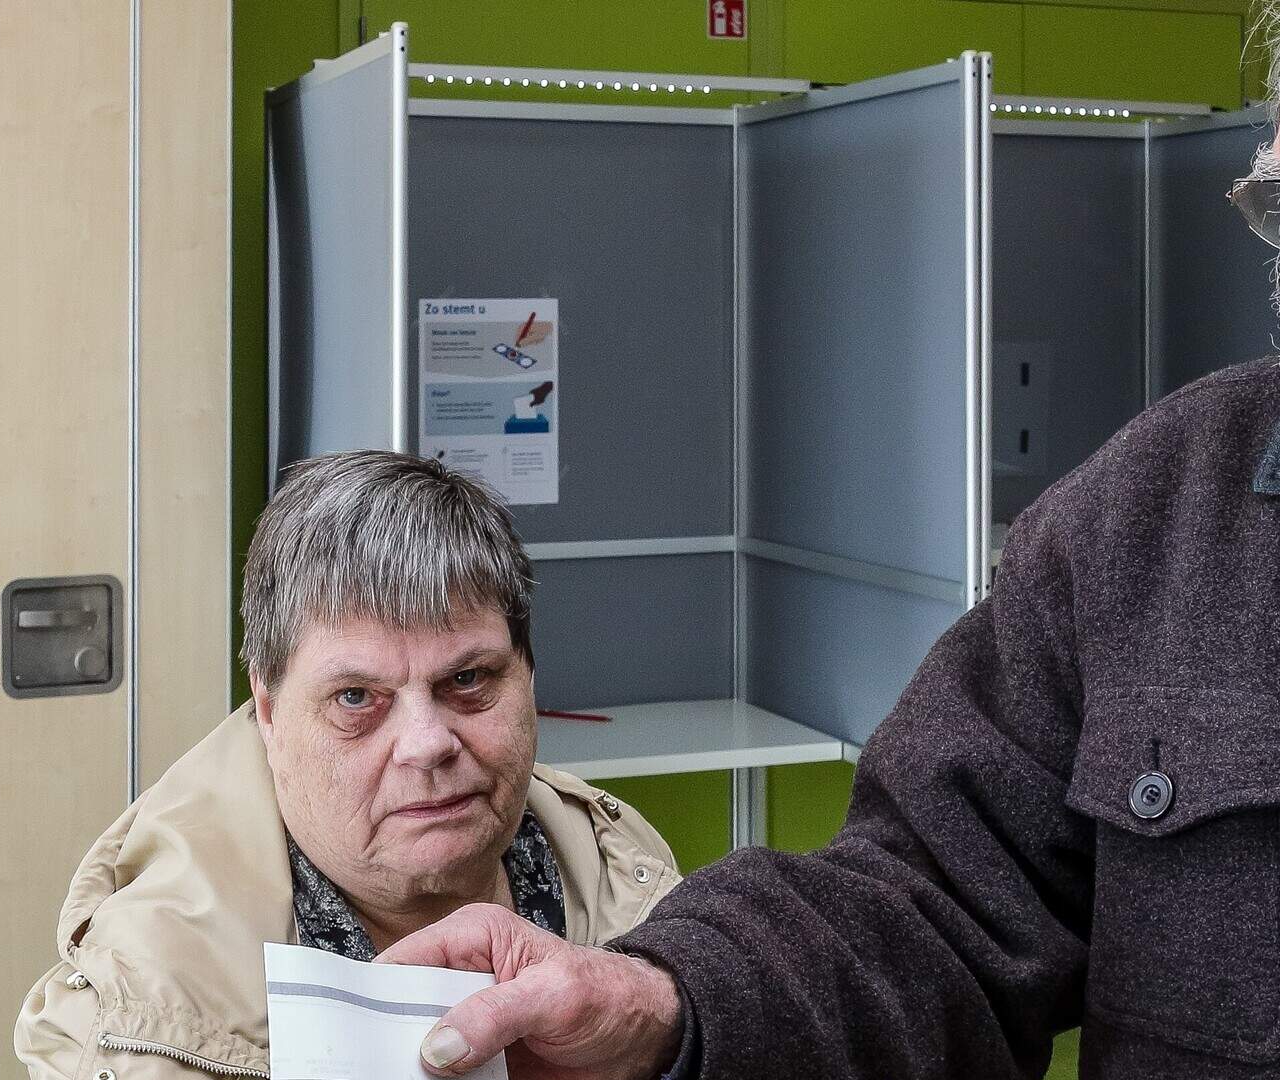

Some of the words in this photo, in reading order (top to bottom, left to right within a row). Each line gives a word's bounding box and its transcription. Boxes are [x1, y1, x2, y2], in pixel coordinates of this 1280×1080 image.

[425, 303, 439, 315] Zo
[442, 304, 475, 315] stemt
[478, 306, 486, 315] u
